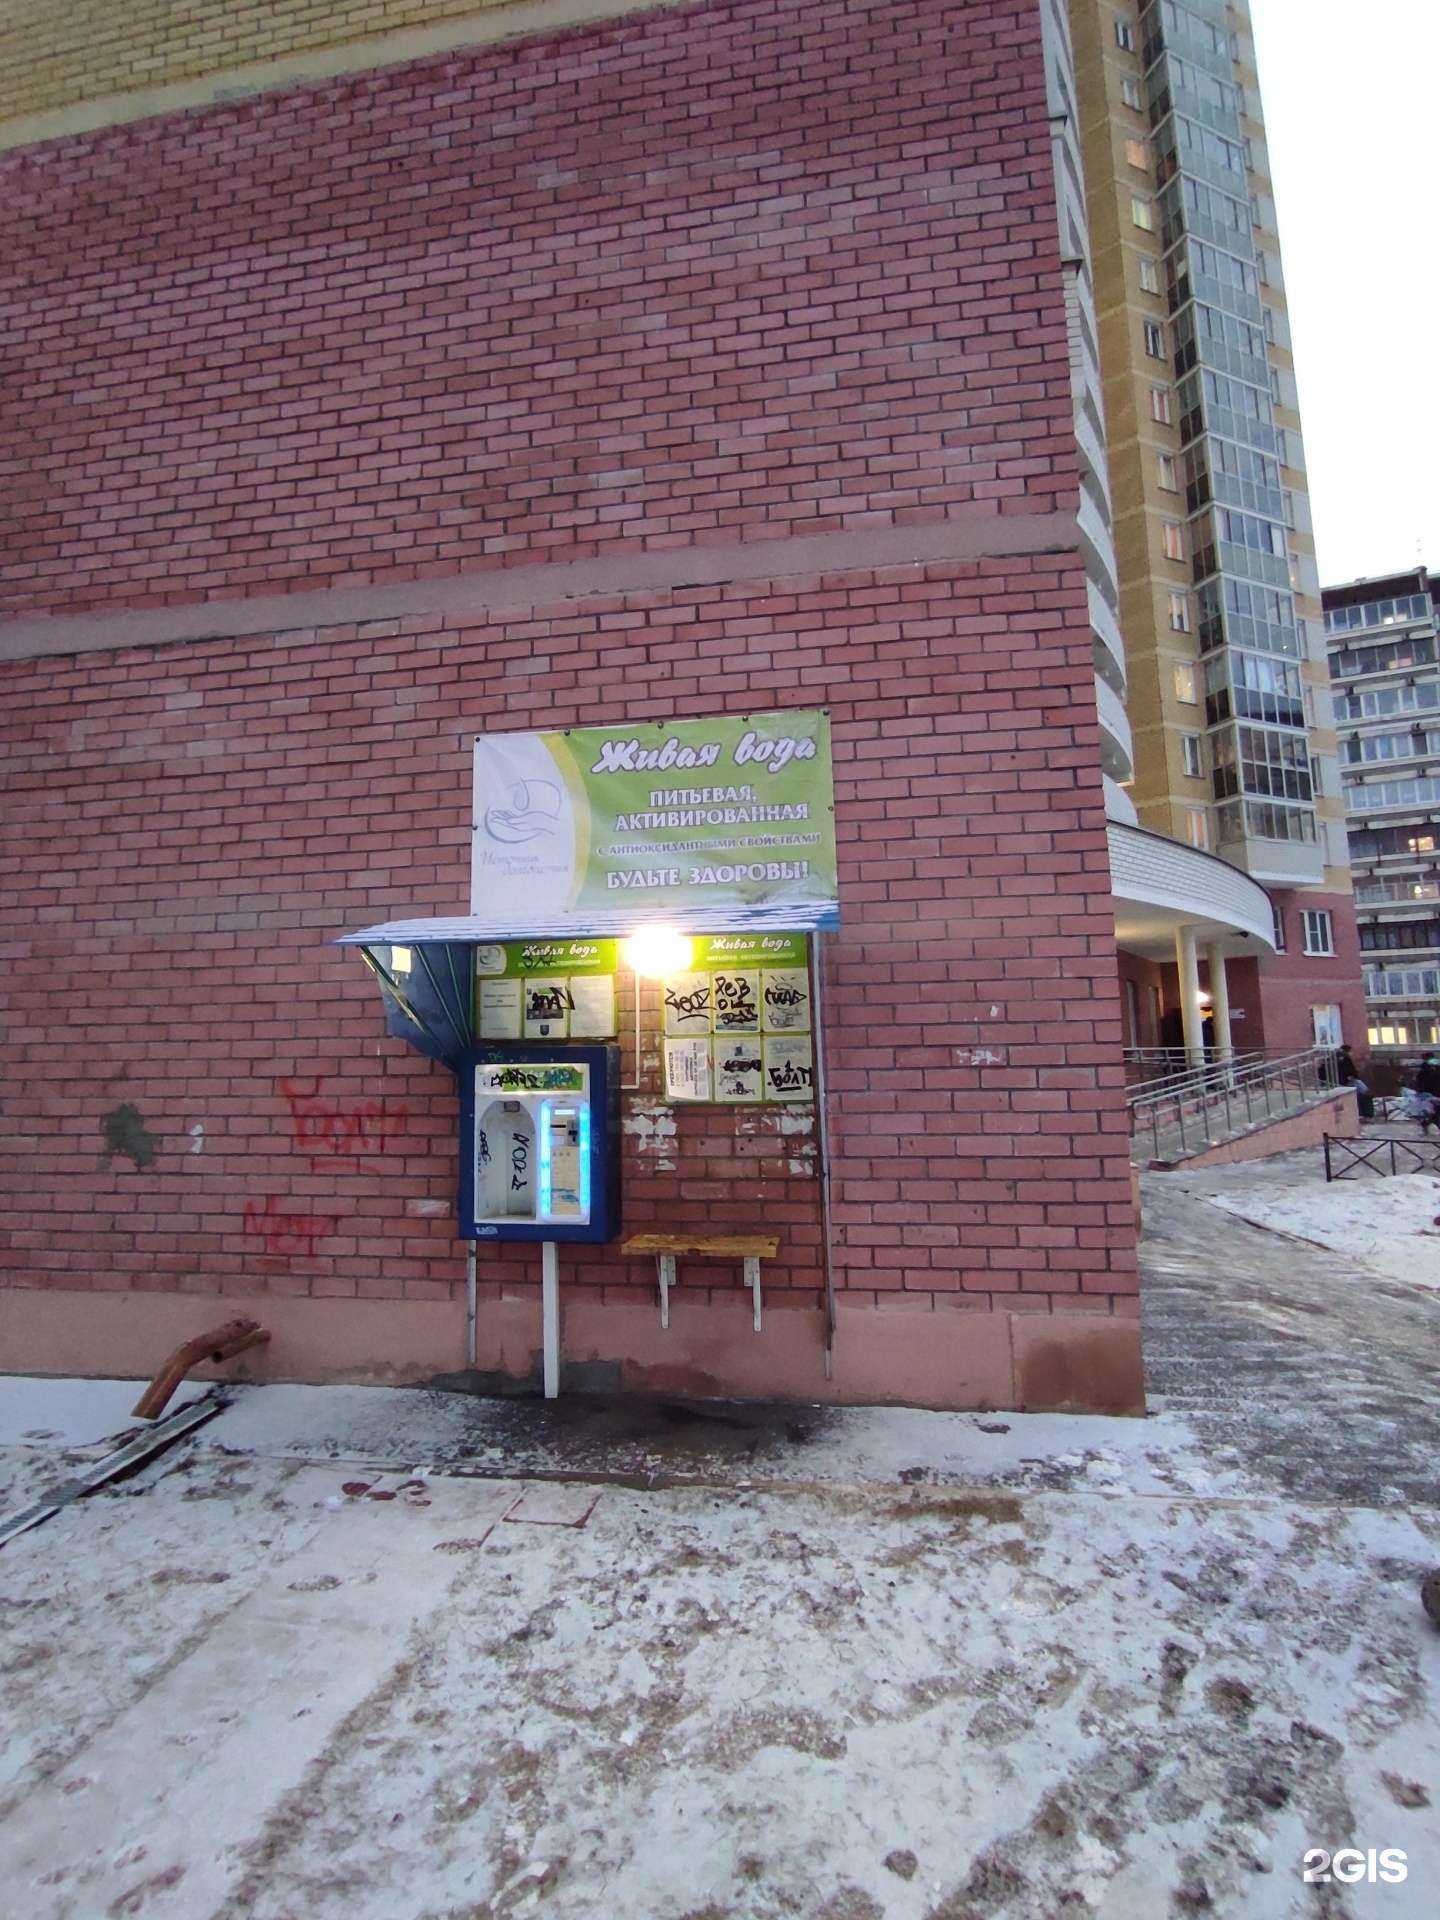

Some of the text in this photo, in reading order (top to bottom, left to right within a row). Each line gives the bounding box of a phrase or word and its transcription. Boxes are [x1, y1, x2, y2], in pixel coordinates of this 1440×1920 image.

[590, 731, 817, 774] Живая вода
[614, 803, 809, 832] АКТИВИРОВАННАЯ
[607, 860, 809, 889] БУДЬТЕ ЗДОРОВЫ!
[569, 943, 598, 958] вода
[709, 936, 792, 952] Живая вода
